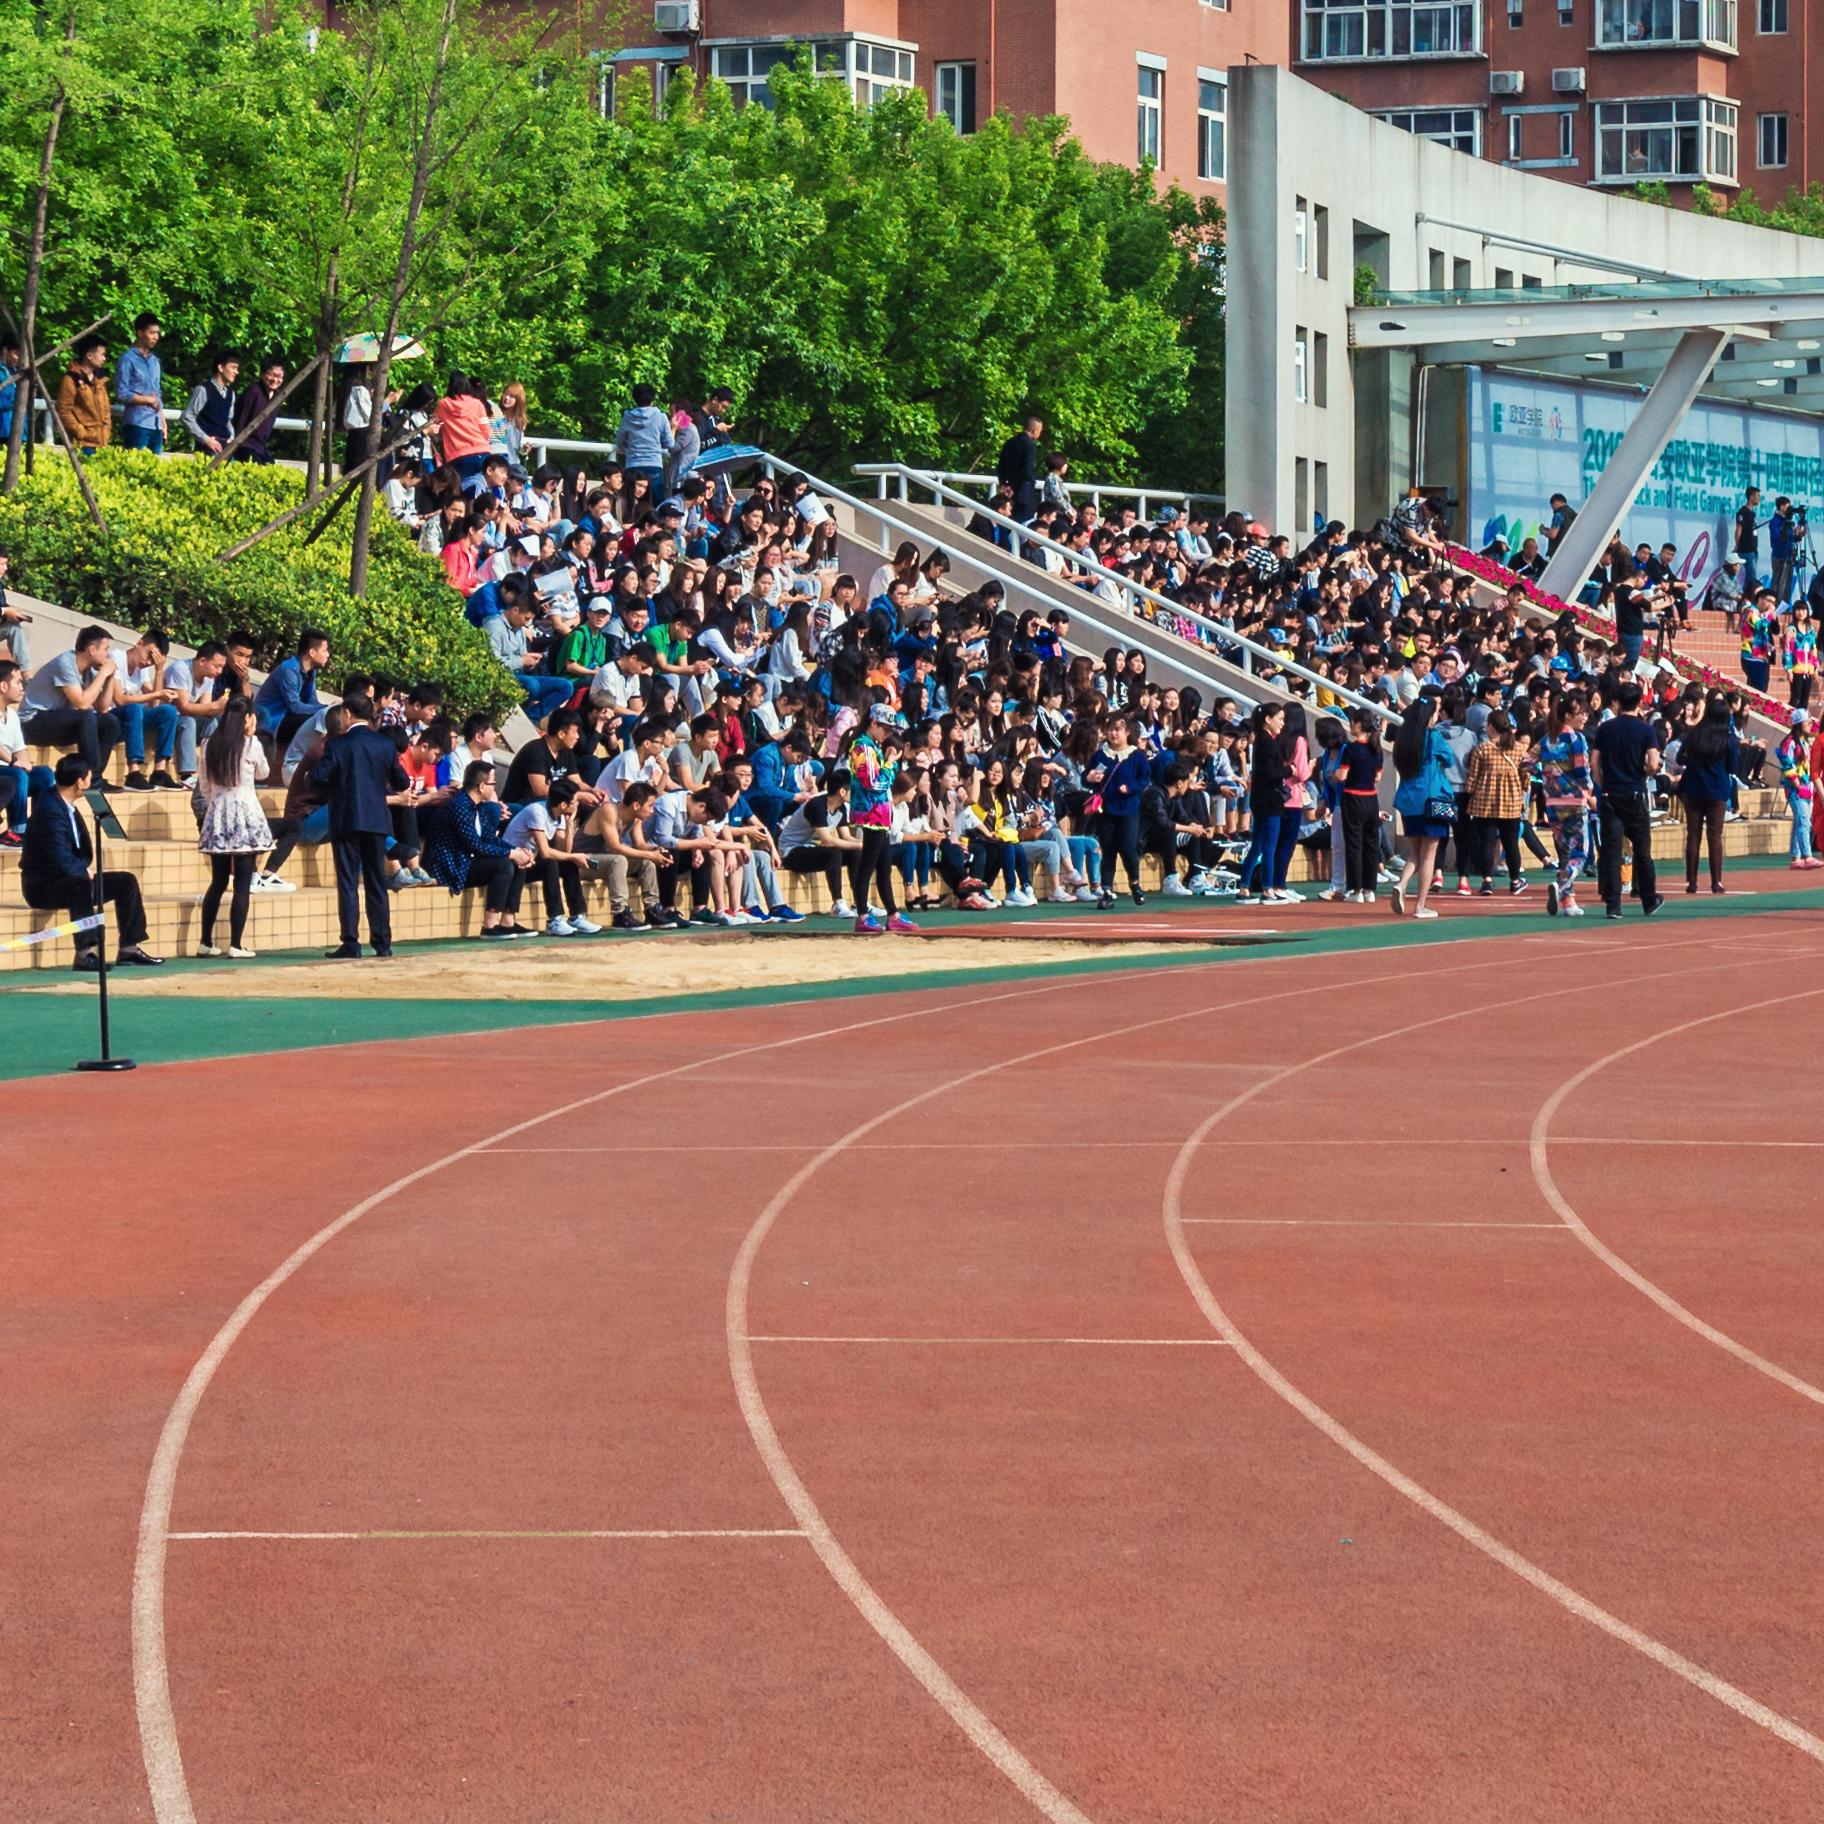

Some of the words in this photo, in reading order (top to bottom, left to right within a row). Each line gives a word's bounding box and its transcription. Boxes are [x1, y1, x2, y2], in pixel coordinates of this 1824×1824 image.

[1509, 404, 1544, 428] 欧亚学院
[1654, 484, 1673, 508] and
[1676, 486, 1698, 512] Field
